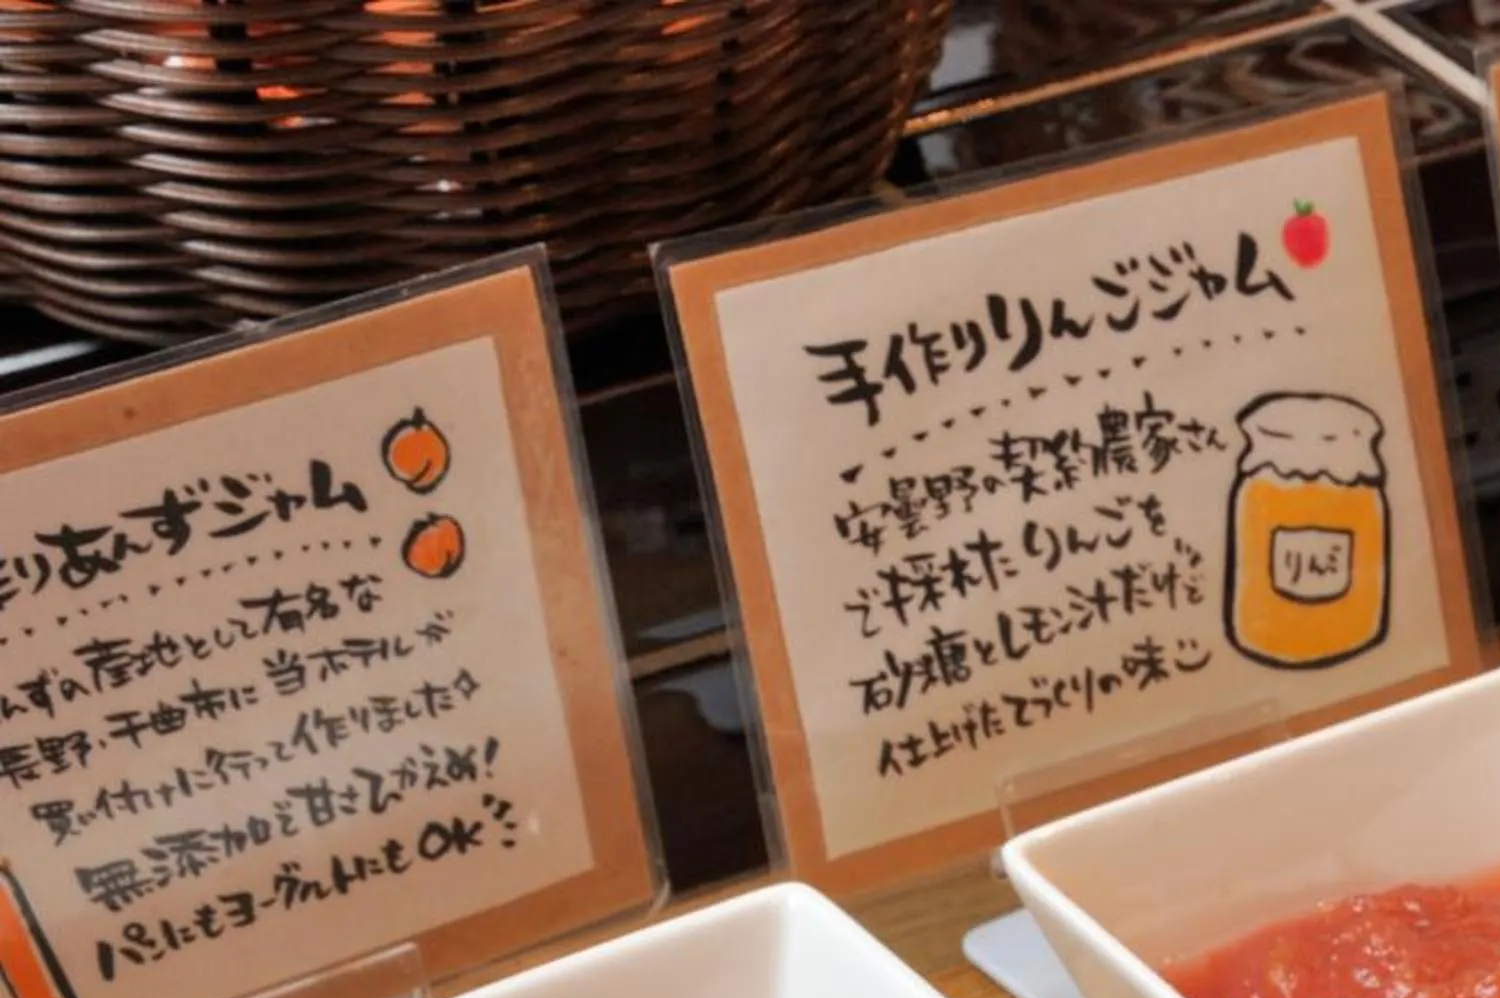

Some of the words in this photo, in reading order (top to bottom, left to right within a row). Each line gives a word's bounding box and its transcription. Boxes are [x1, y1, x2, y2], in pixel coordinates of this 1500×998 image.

[804, 231, 1296, 426] 手作りりんごジャム
[833, 391, 1229, 556] 安曇野の契約農家さん
[844, 493, 1168, 638] で採れたりんごを
[849, 562, 1204, 715] 砂糖とレモン汁だけで
[1284, 545, 1341, 586] りんご
[878, 635, 1170, 778] 仕上げたてづくりの味
